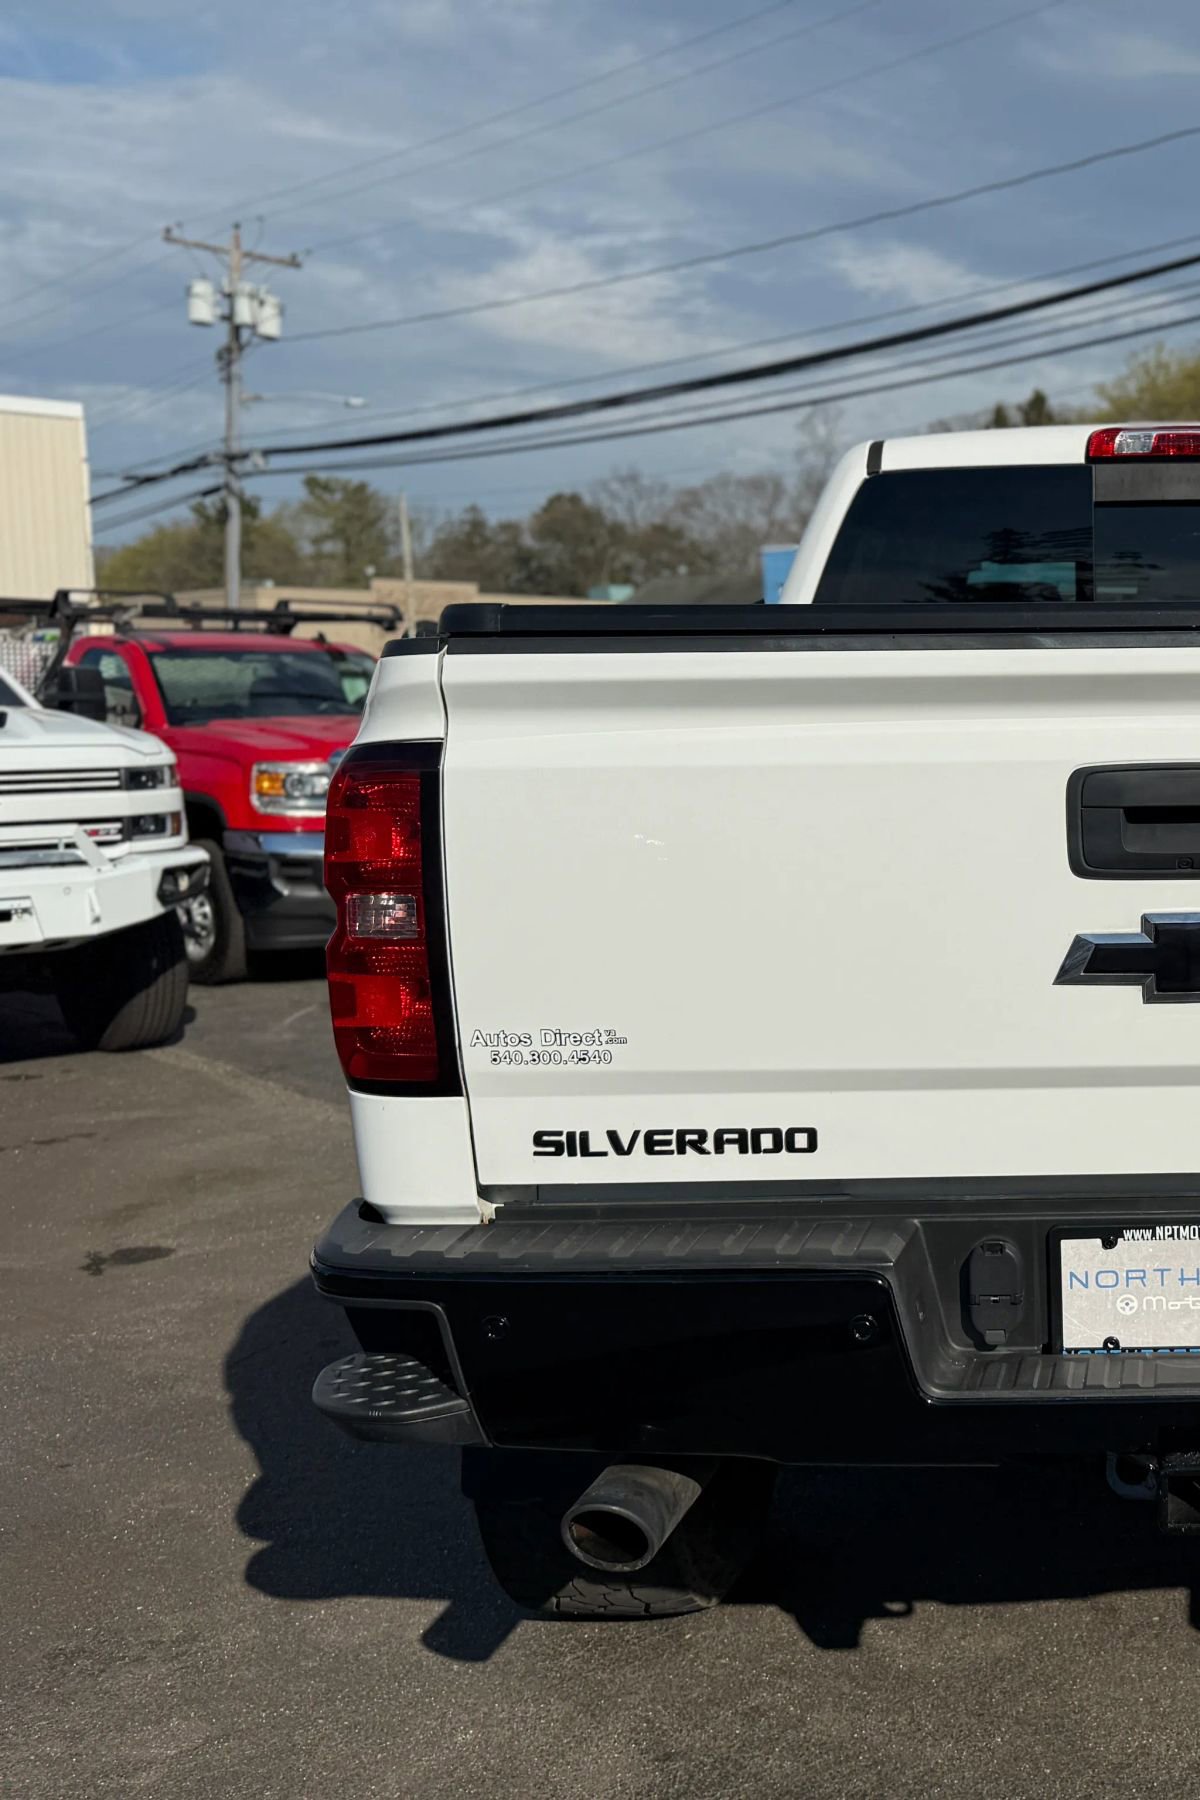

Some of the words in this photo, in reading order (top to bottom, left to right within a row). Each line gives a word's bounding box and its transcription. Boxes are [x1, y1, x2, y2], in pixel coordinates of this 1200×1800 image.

[470, 1029, 532, 1047] Autos
[540, 1029, 602, 1046] Direct
[490, 1050, 612, 1065] 540.300.4540
[533, 1127, 818, 1157] SILVERADO
